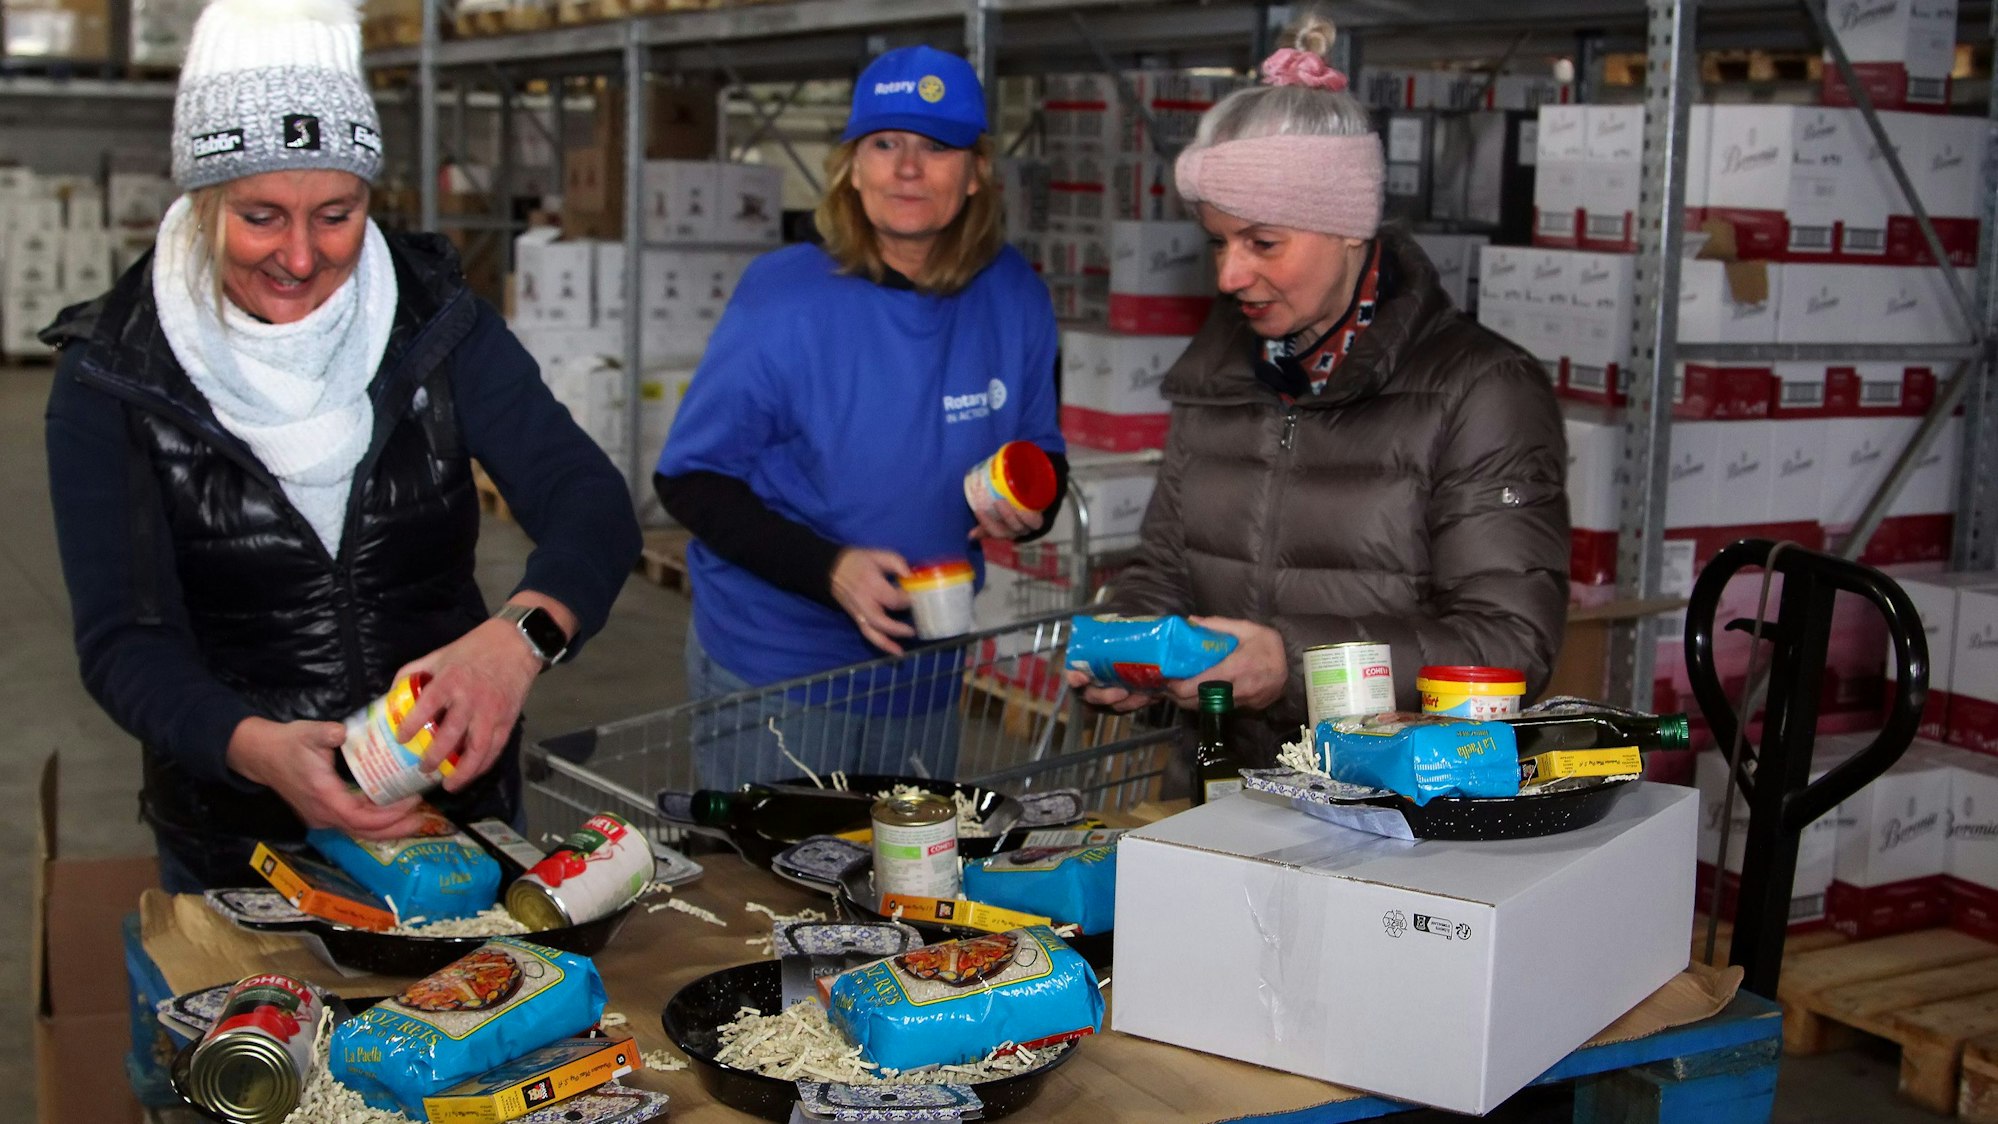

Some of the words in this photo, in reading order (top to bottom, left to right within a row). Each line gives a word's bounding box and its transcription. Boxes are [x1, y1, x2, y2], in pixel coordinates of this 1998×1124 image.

[874, 80, 916, 96] Rotary
[943, 392, 988, 411] Rotary
[1456, 740, 1485, 760] Paella
[1483, 736, 1497, 751] La
[344, 1047, 355, 1063] La
[357, 1046, 382, 1063] Paella
